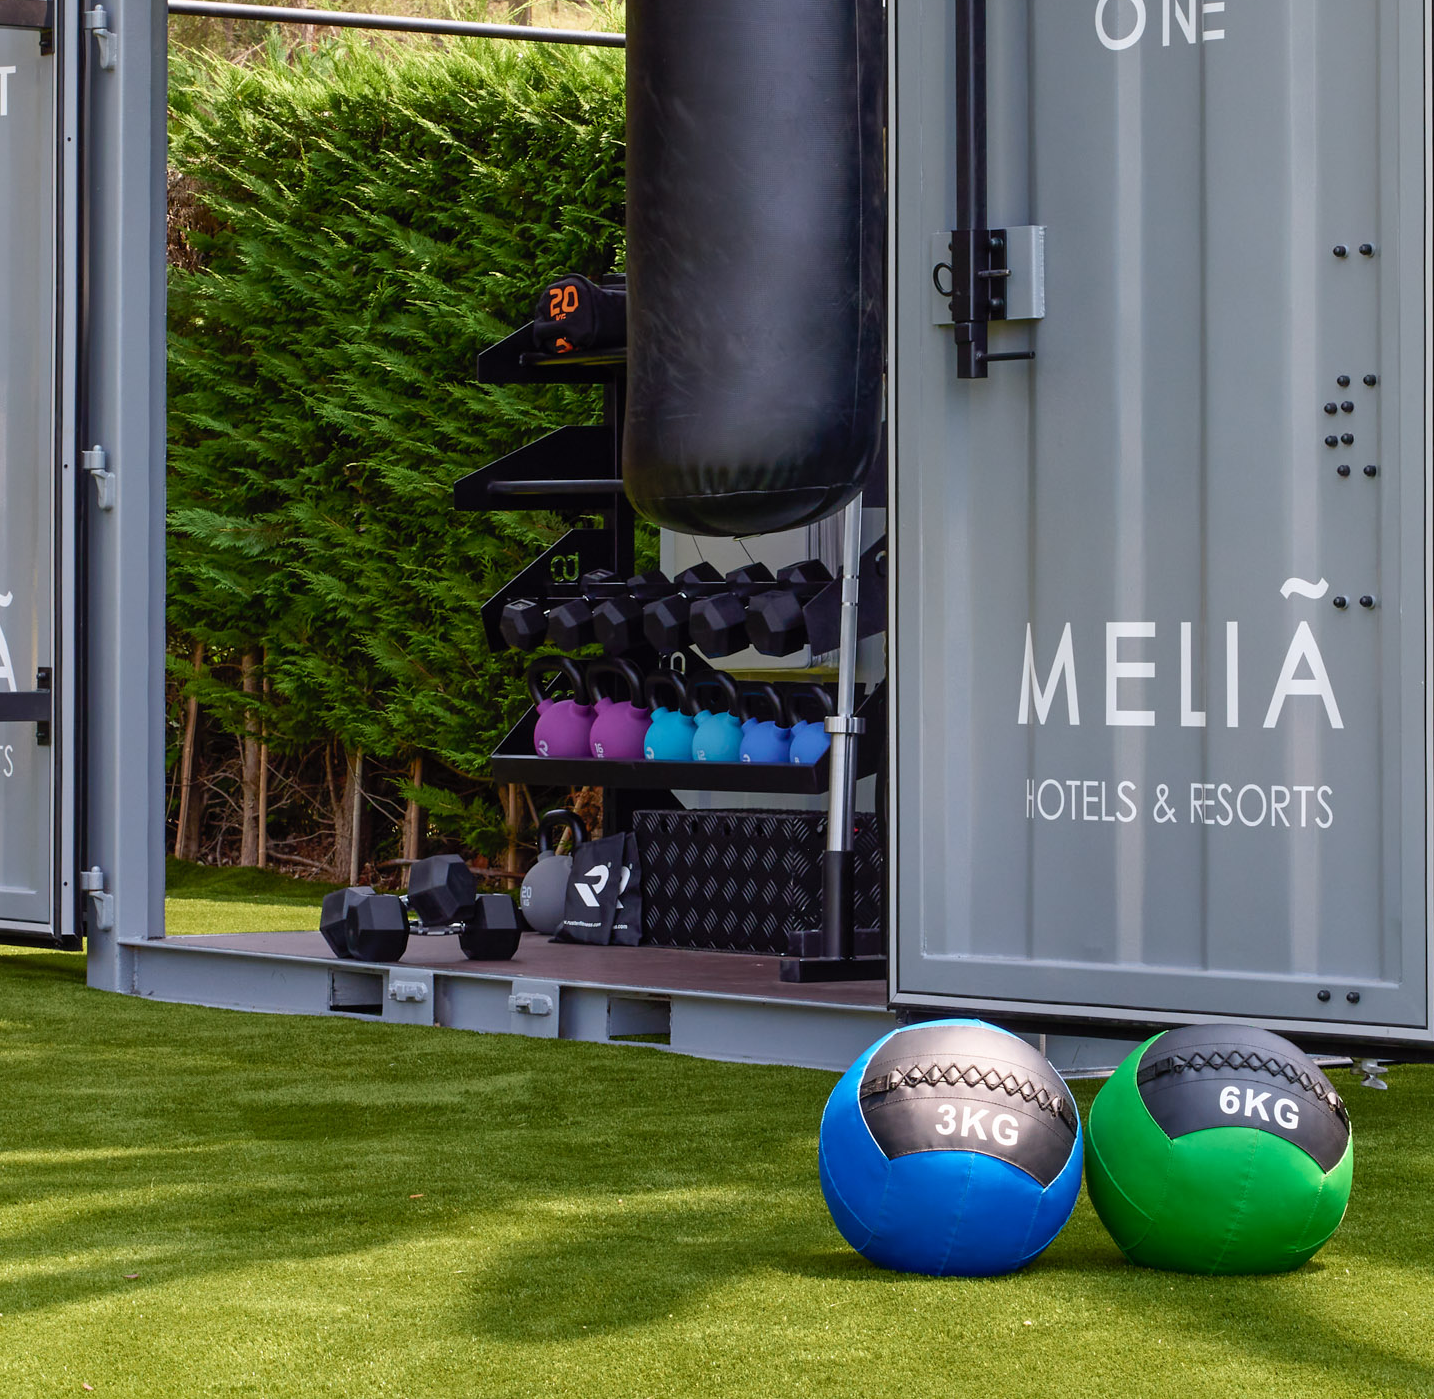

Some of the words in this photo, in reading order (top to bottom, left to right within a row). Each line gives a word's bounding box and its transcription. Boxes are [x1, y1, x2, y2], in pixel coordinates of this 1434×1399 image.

[549, 285, 579, 318] 20
[1026, 778, 1138, 823] HOTELS
[1152, 786, 1178, 823] &
[1190, 781, 1334, 829] RESORTS
[521, 886, 532, 899] 20
[934, 1103, 1020, 1147] 3KG
[1218, 1085, 1301, 1131] 6KG
